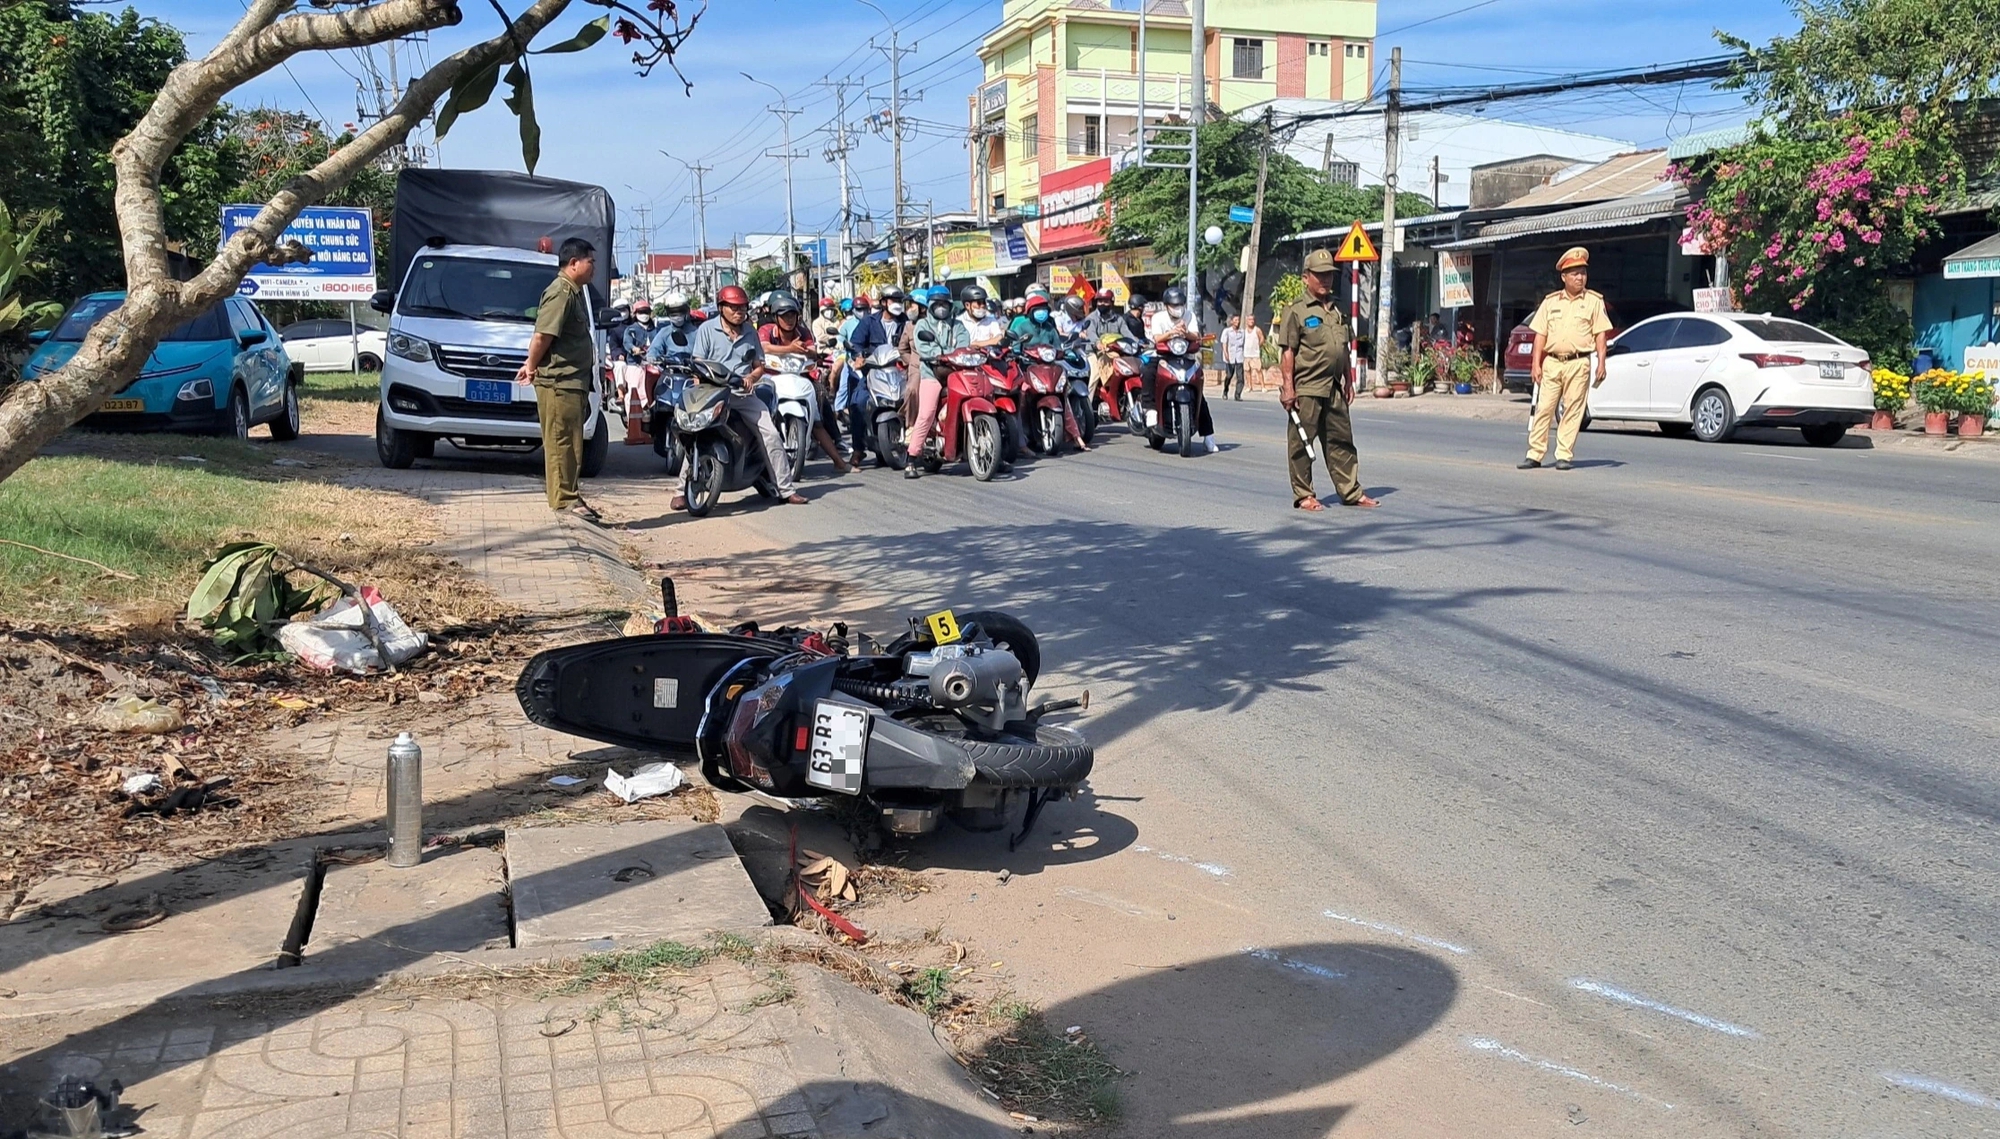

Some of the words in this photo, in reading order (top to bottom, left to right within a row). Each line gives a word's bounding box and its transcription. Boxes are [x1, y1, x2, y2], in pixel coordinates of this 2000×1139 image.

[327, 217, 345, 229] NHÂN
[321, 235, 344, 246] CHUNG
[470, 390, 506, 402] 013.58
[938, 616, 951, 637] 5
